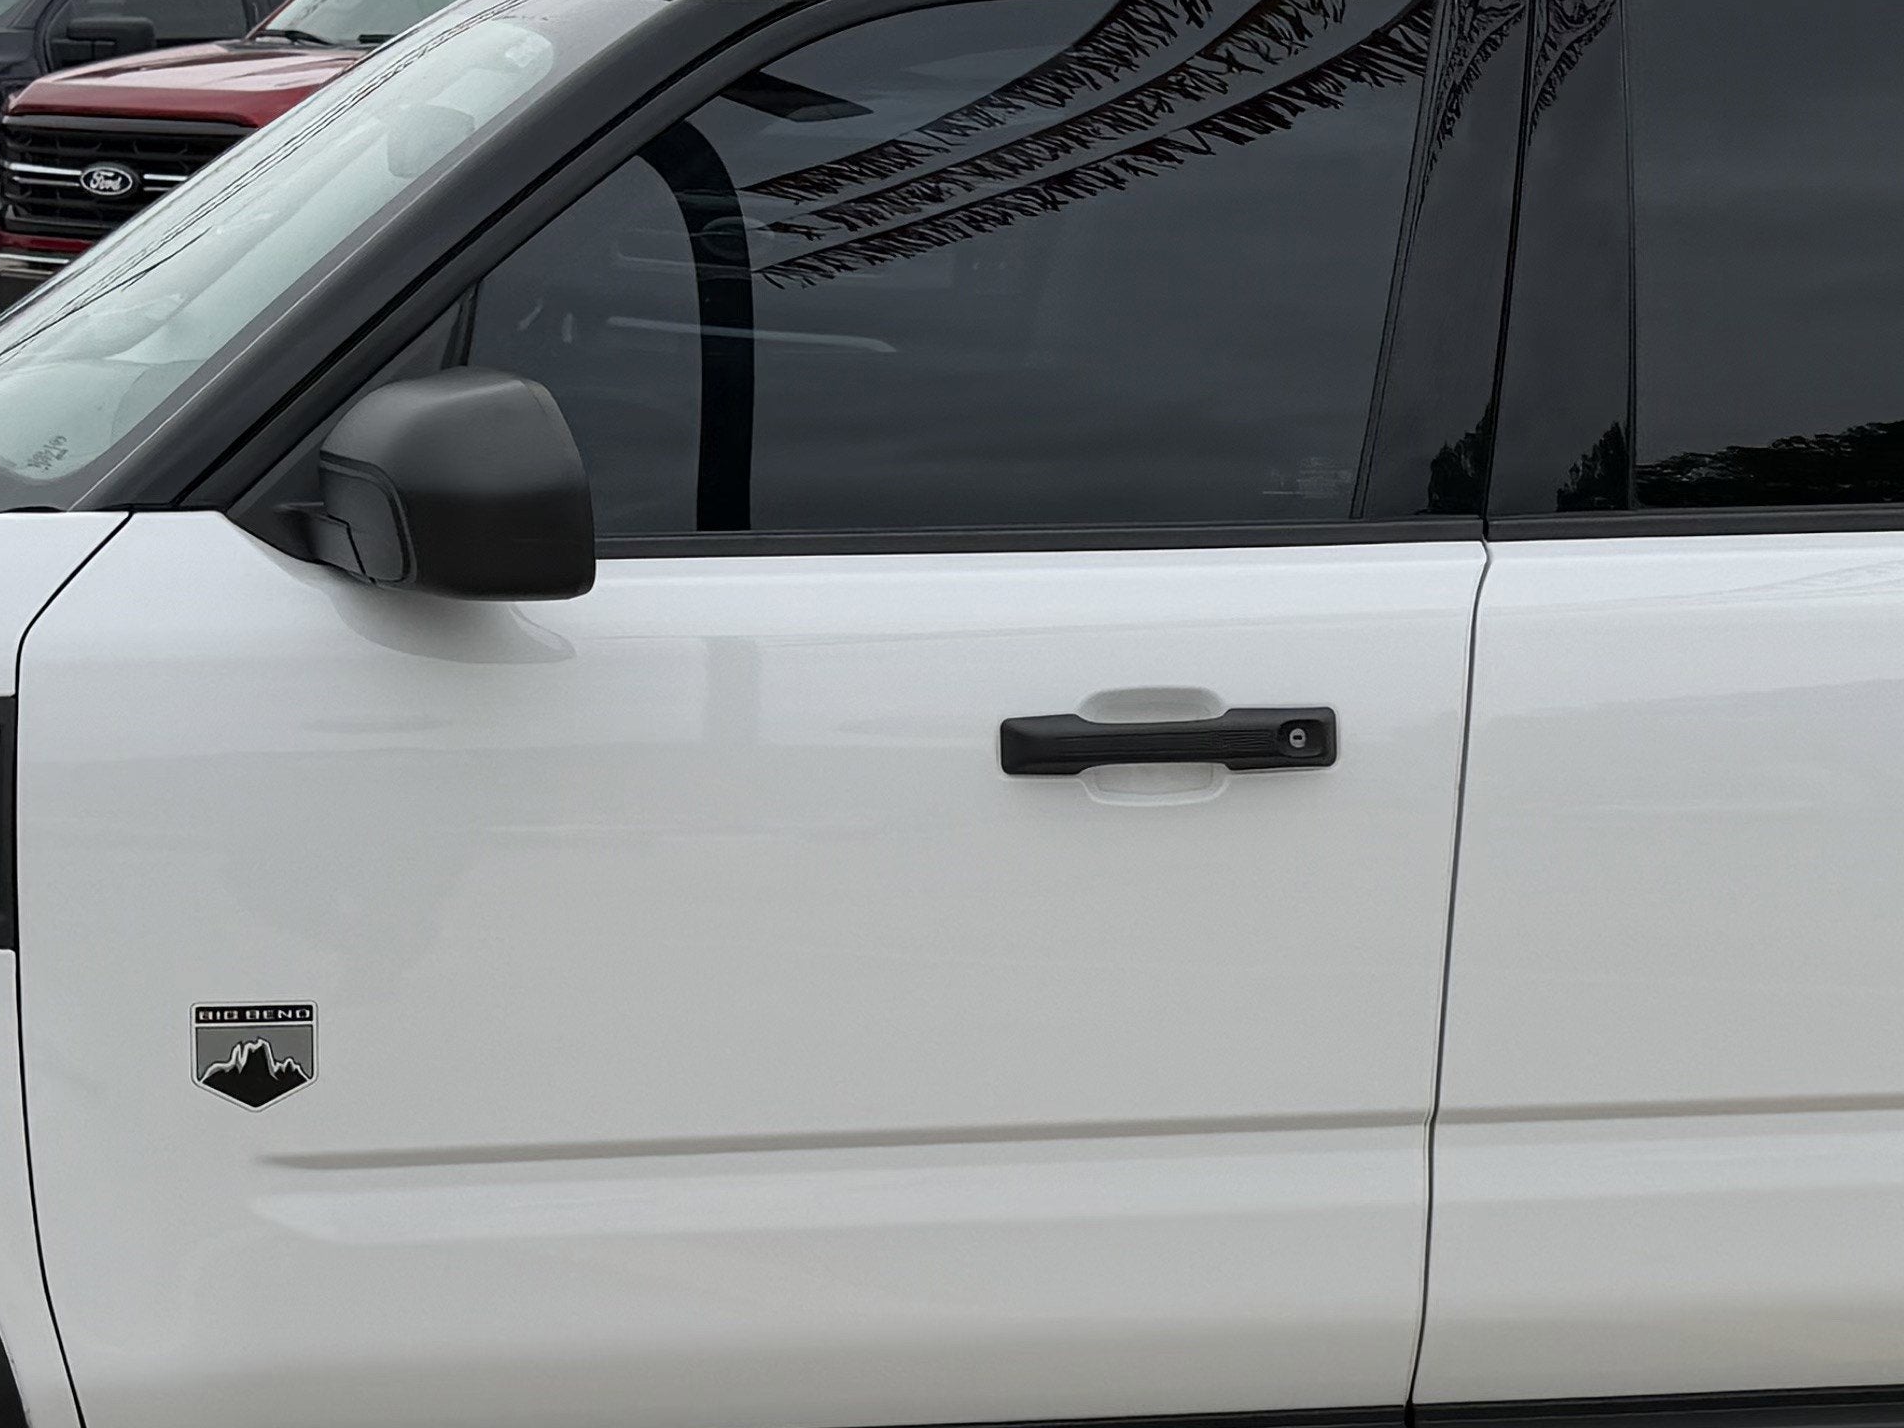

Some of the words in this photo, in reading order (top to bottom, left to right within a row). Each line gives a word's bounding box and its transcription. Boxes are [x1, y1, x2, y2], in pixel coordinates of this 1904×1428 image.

[90, 171, 123, 191] Ford
[199, 1010, 239, 1021] BIG
[245, 1008, 310, 1020] BEND
